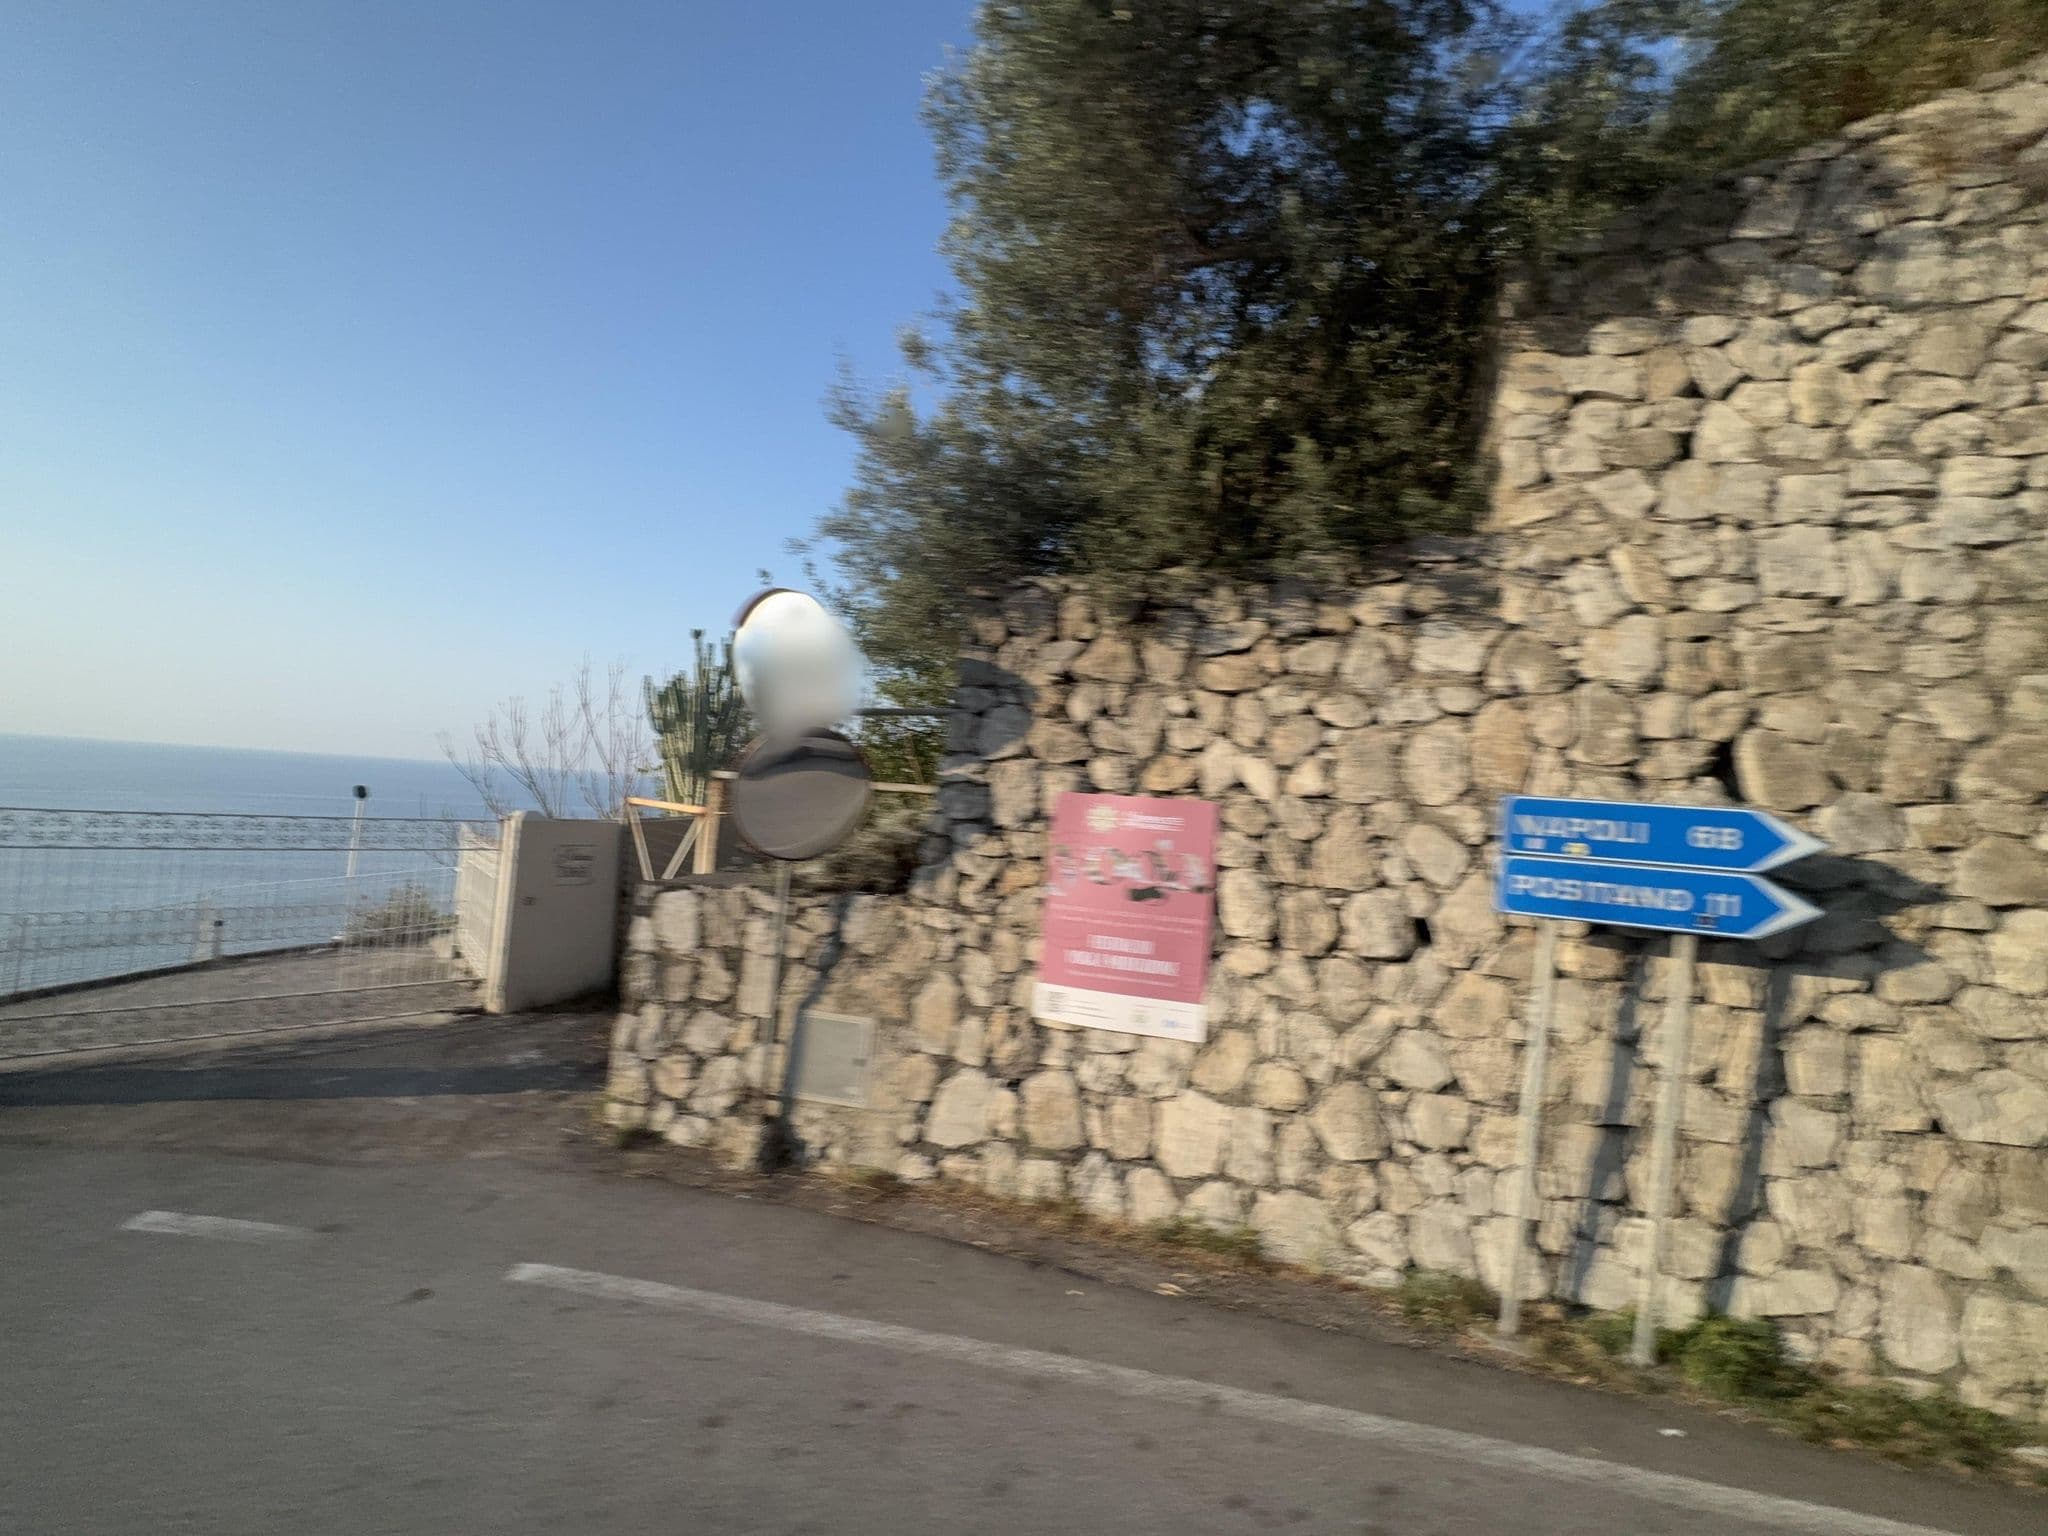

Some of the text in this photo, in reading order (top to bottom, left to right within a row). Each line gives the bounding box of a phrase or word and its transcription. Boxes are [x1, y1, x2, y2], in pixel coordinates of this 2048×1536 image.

[1512, 814, 1650, 844] NAPOLI
[1507, 875, 1742, 917] POSITANO 11
